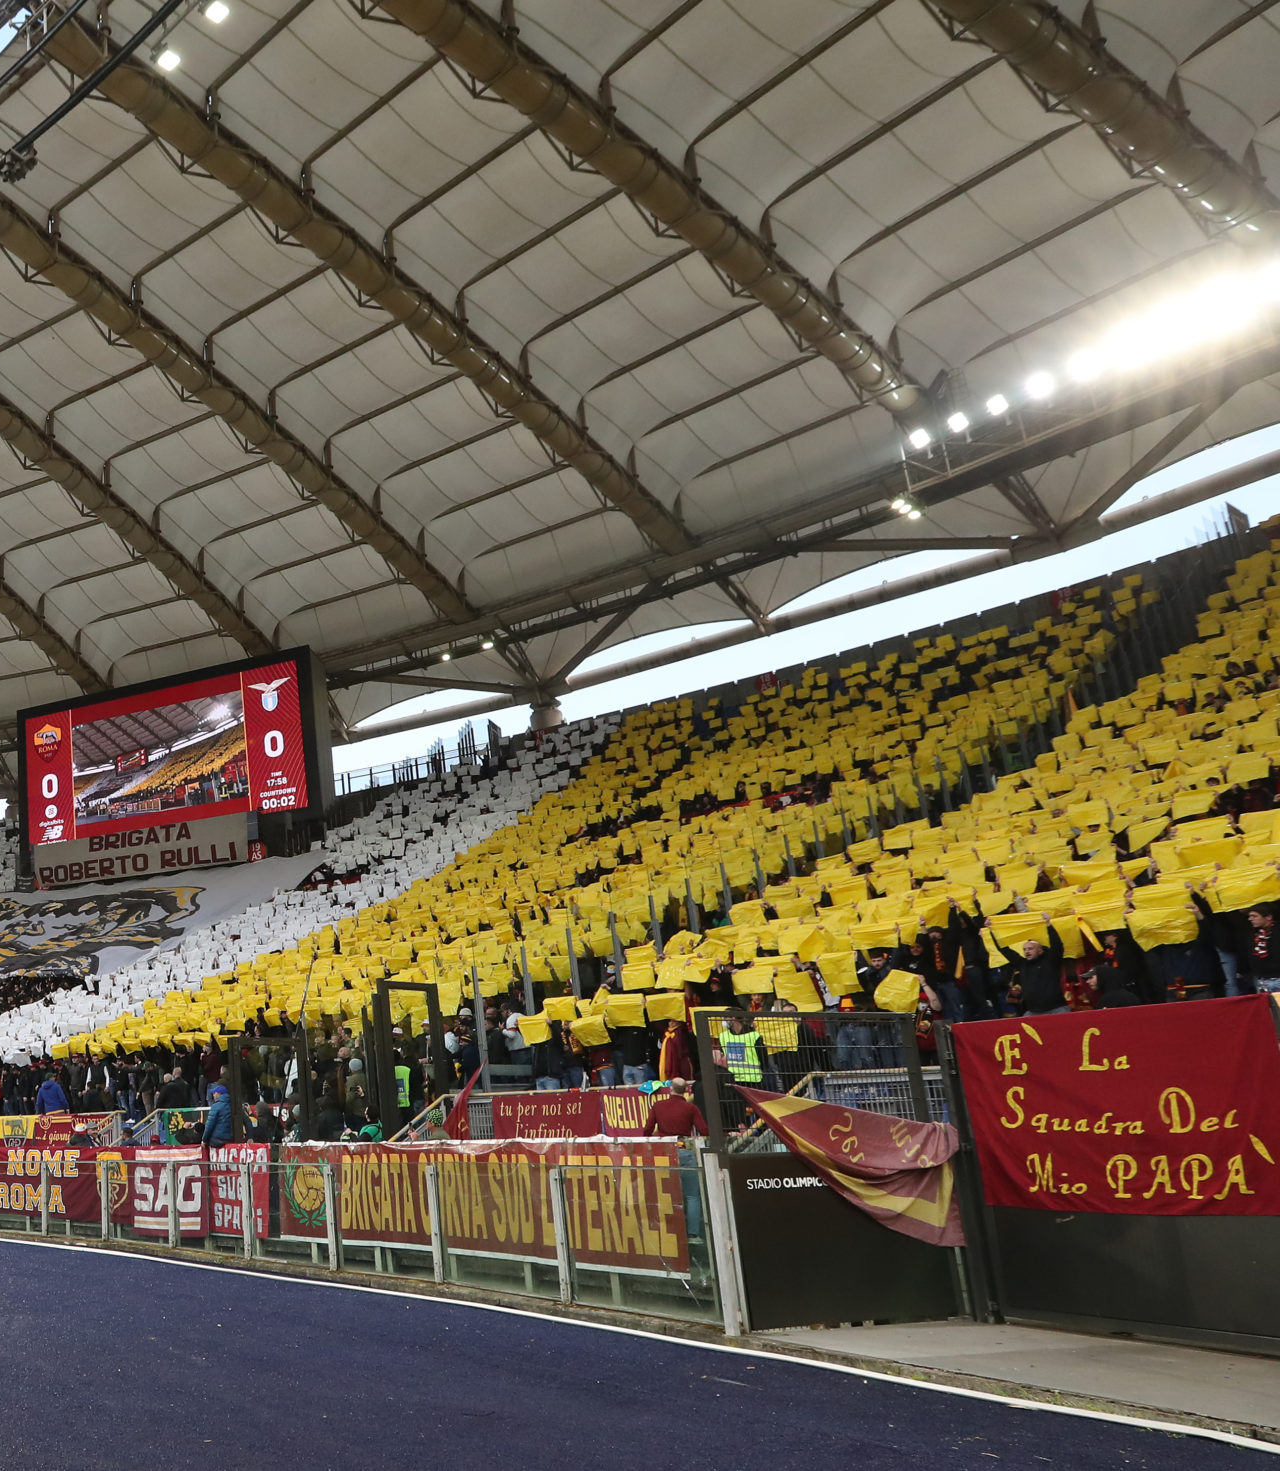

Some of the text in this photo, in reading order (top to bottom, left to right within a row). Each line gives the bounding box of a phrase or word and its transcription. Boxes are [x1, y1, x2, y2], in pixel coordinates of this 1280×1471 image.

[263, 729, 285, 758] 0
[41, 773, 59, 799] 0
[260, 786, 297, 798] COUNTDOWN
[266, 776, 288, 787] 17:58
[261, 795, 296, 810] 00:02
[88, 822, 192, 853] BRIGATA
[39, 841, 237, 884] ROBERTO RULLI
[1078, 1027, 1131, 1071] La
[499, 1095, 583, 1123] tu per noi sei
[603, 1094, 639, 1129] QUELLI
[1000, 1086, 1145, 1136] Squadra
[6, 1148, 81, 1178] NOME
[1026, 1152, 1089, 1195] Mio
[133, 1164, 202, 1213] SAG
[746, 1177, 782, 1190] STADIO
[341, 1152, 680, 1258] BRIGATA CURVA SUD LATERALE
